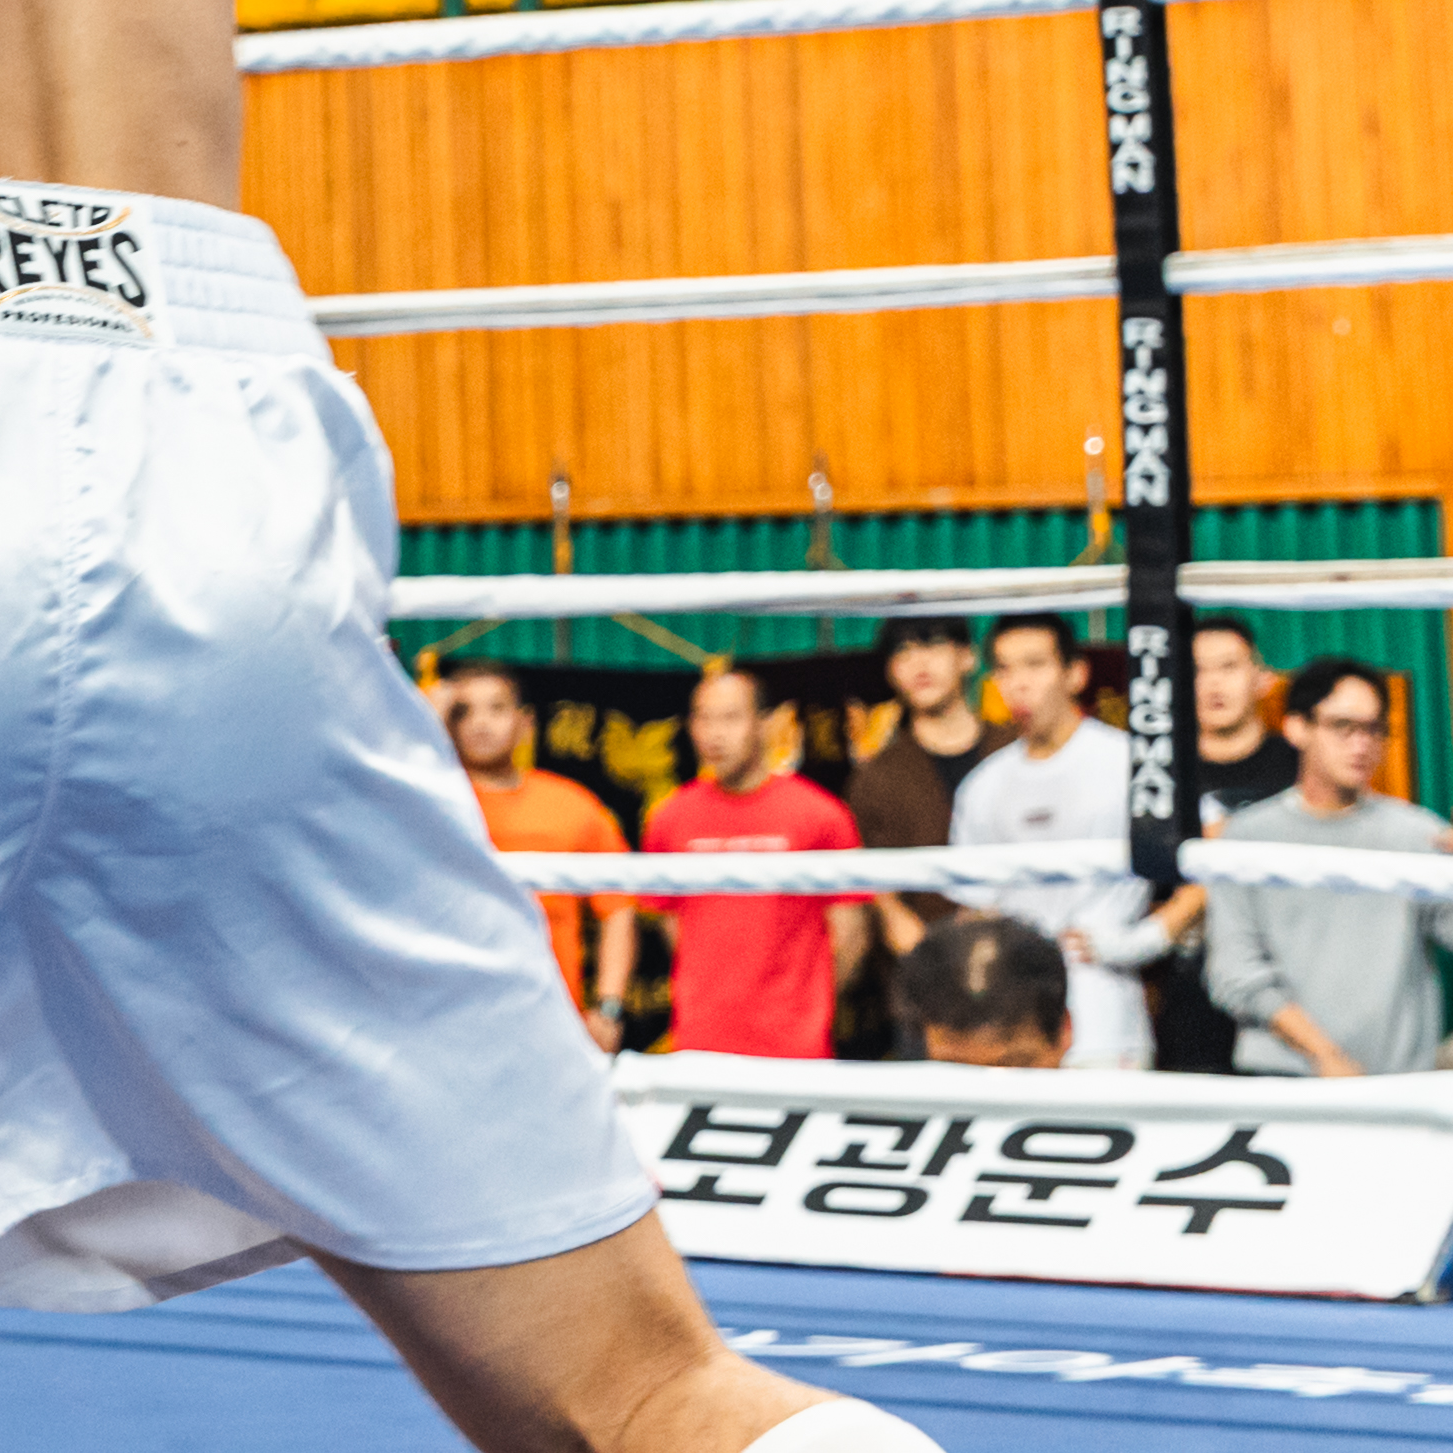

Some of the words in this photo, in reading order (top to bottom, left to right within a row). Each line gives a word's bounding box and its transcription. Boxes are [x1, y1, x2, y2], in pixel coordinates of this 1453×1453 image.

[1102, 3, 1156, 196] RINGMAN
[1121, 316, 1170, 510] RINGMAN
[1127, 622, 1176, 821] RINGMAN
[660, 1102, 1293, 1235] 보광운수
